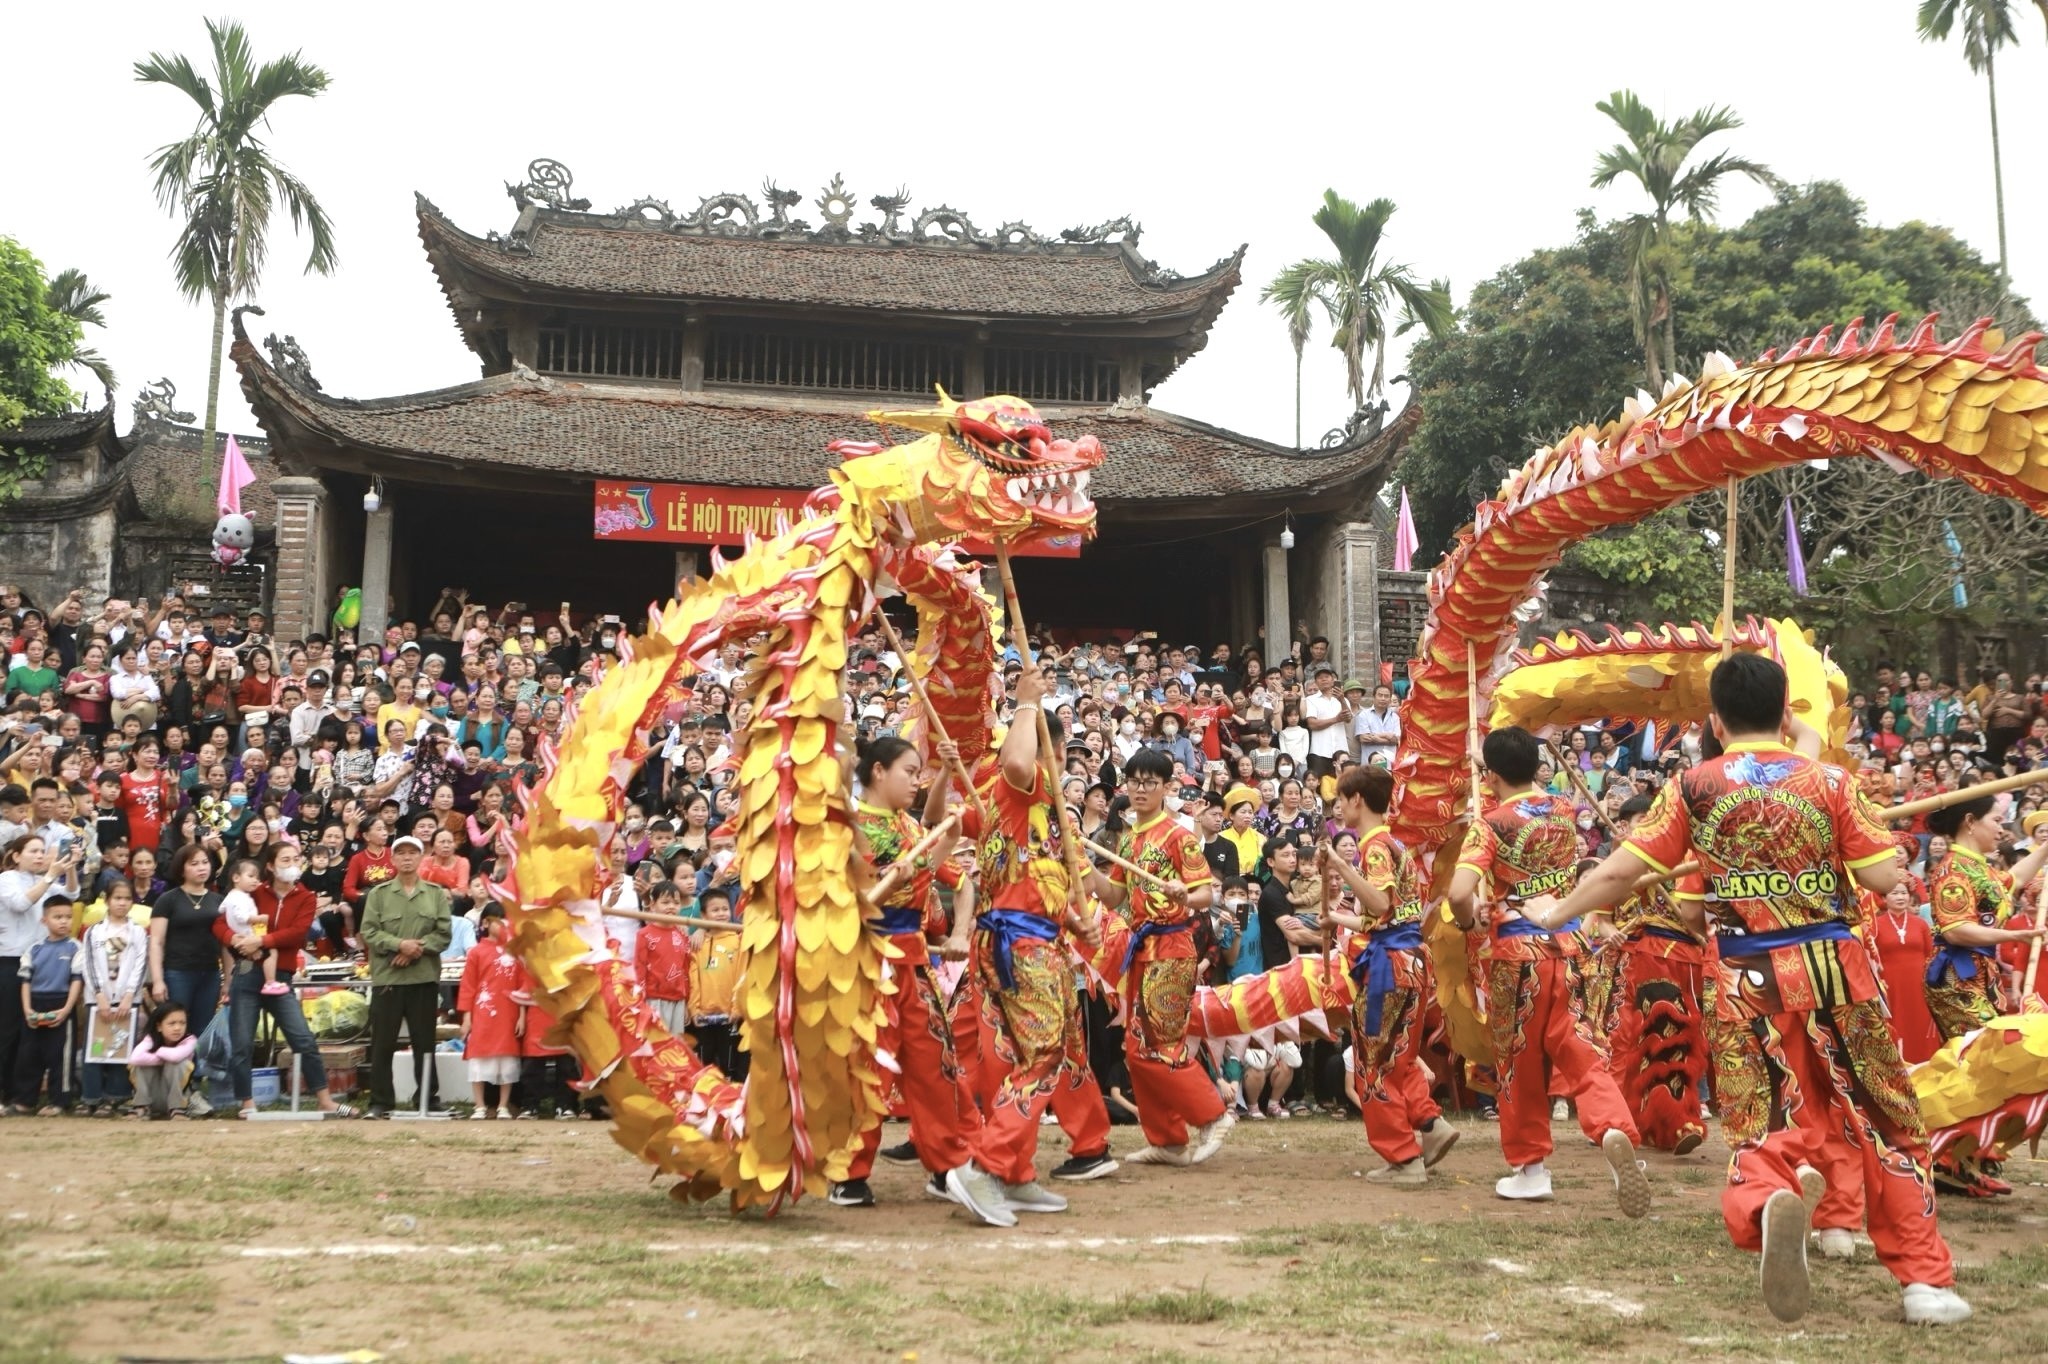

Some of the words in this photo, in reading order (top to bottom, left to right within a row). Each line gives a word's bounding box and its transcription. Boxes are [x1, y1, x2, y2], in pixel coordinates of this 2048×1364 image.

[667, 491, 688, 531] LỄ
[692, 497, 723, 540] HỘI
[1517, 869, 1568, 898] LÀNG
[1714, 869, 1793, 899] LÀNG
